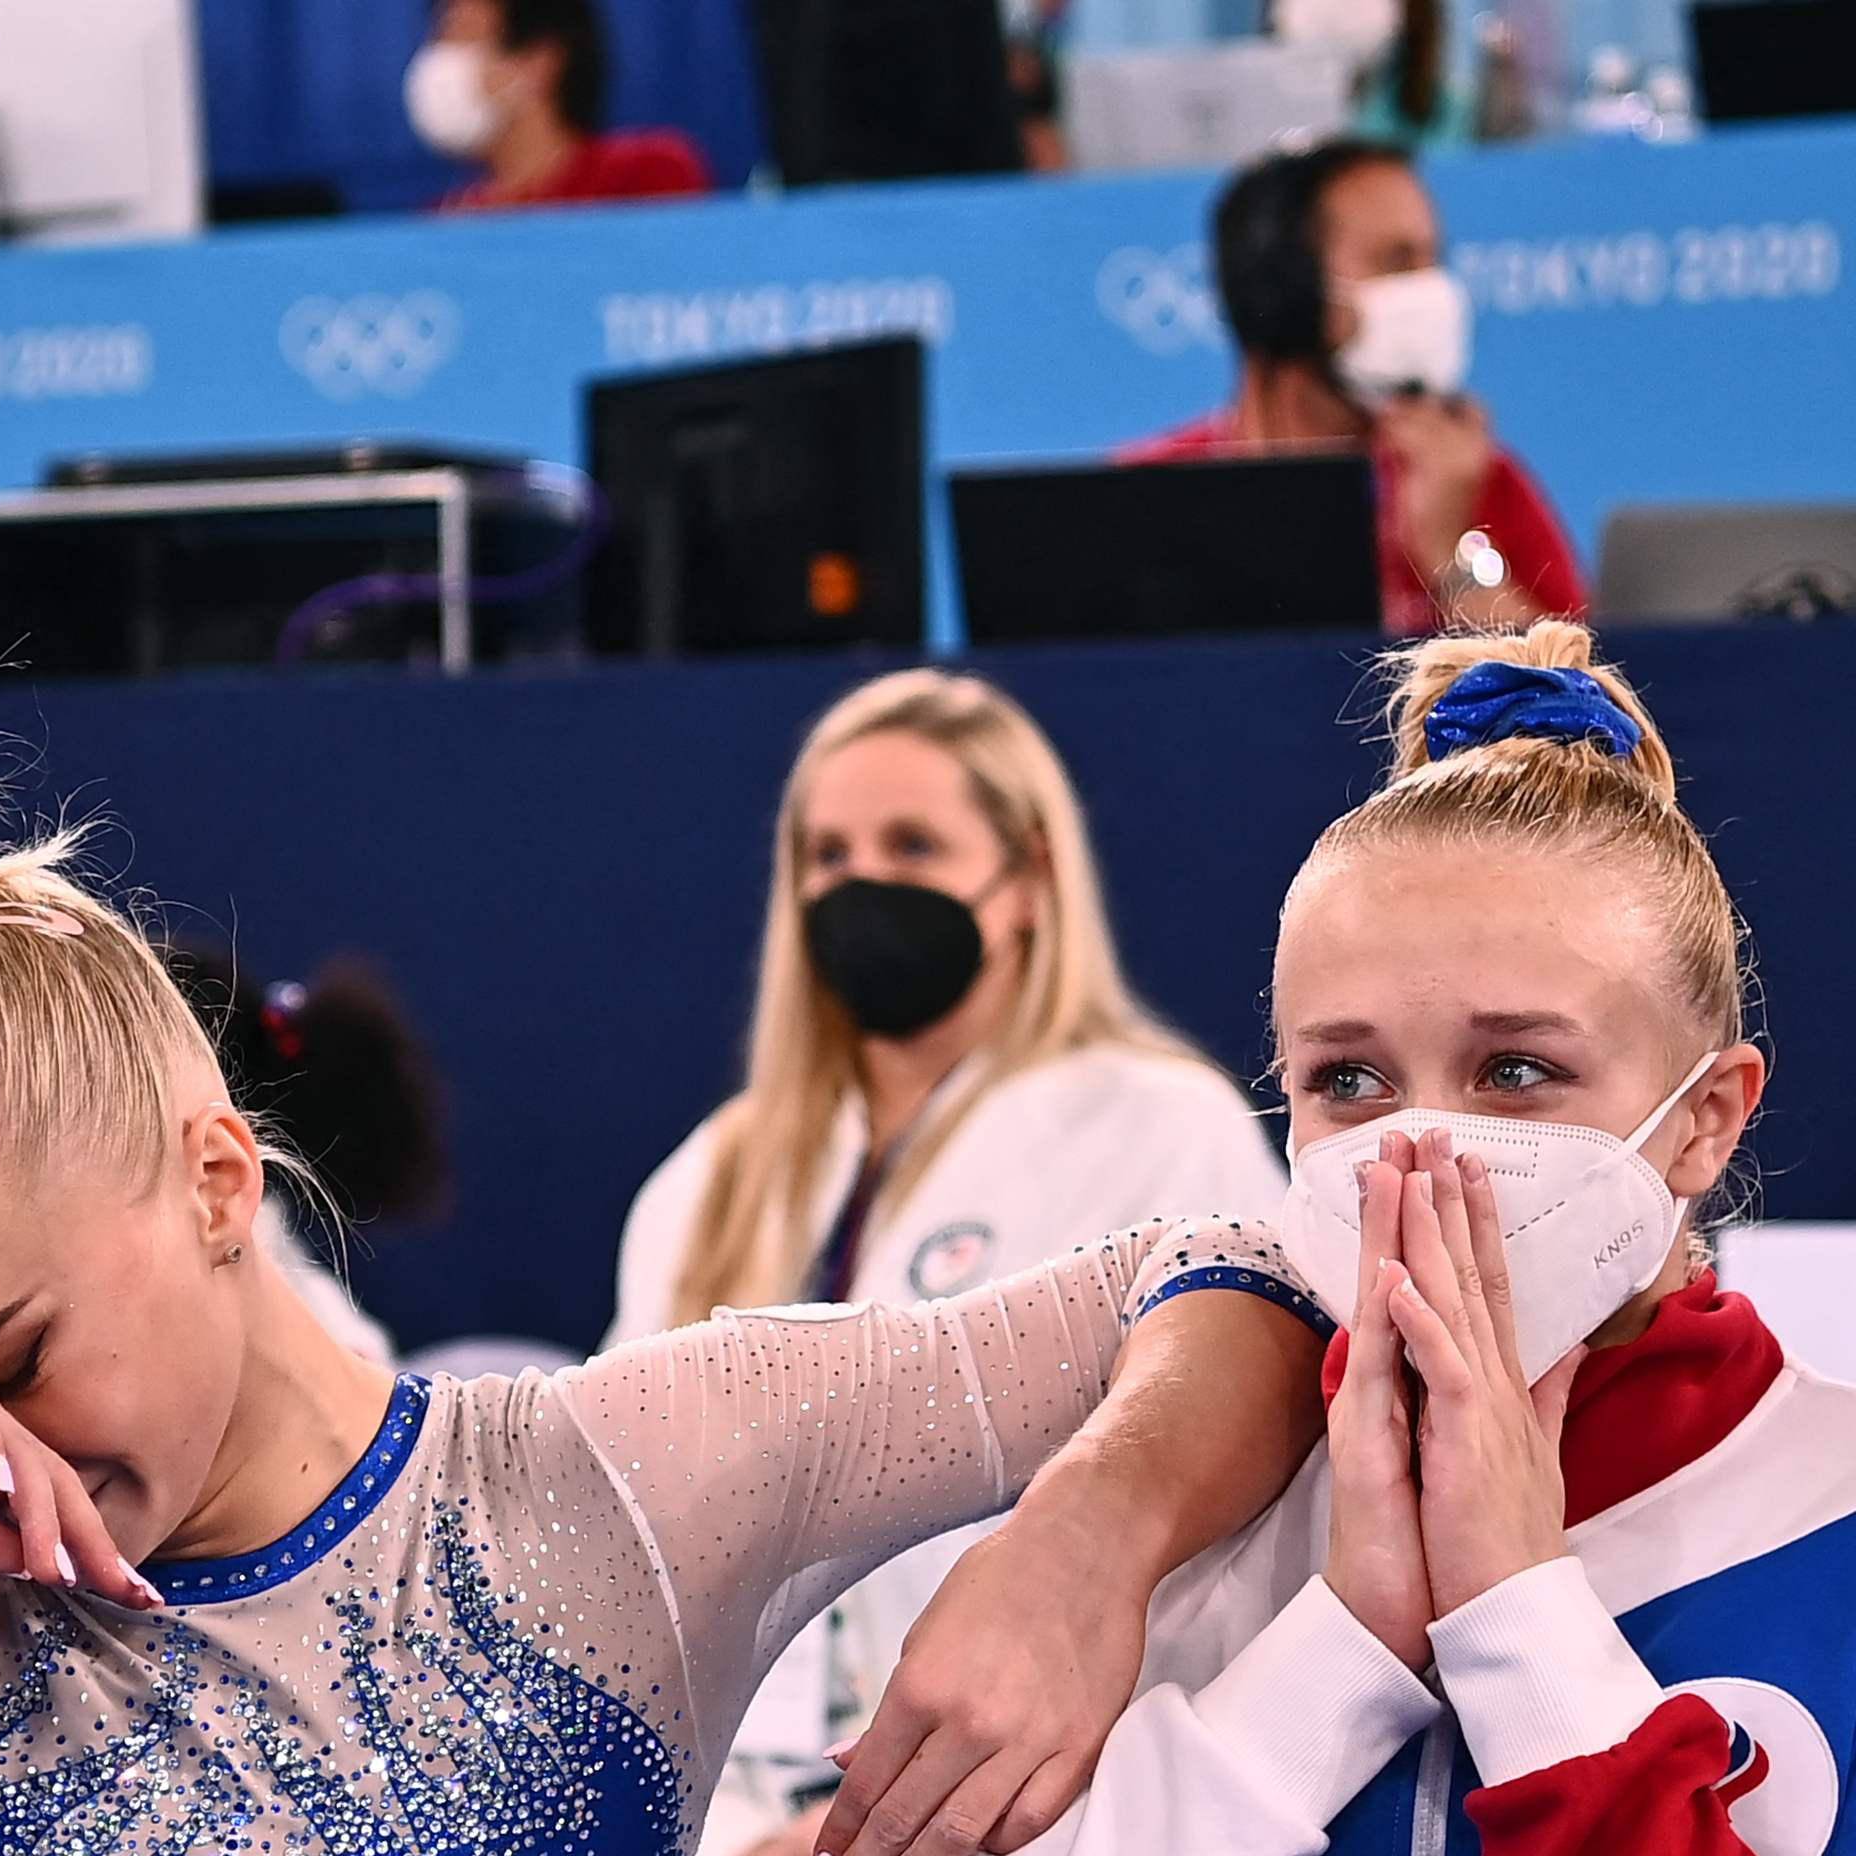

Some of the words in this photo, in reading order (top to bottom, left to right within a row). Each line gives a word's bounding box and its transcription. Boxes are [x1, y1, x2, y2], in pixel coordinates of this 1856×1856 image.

[1456, 231, 1668, 313] TOKYO
[1674, 215, 1840, 301] 2020
[1593, 1219, 1645, 1271] KN95
